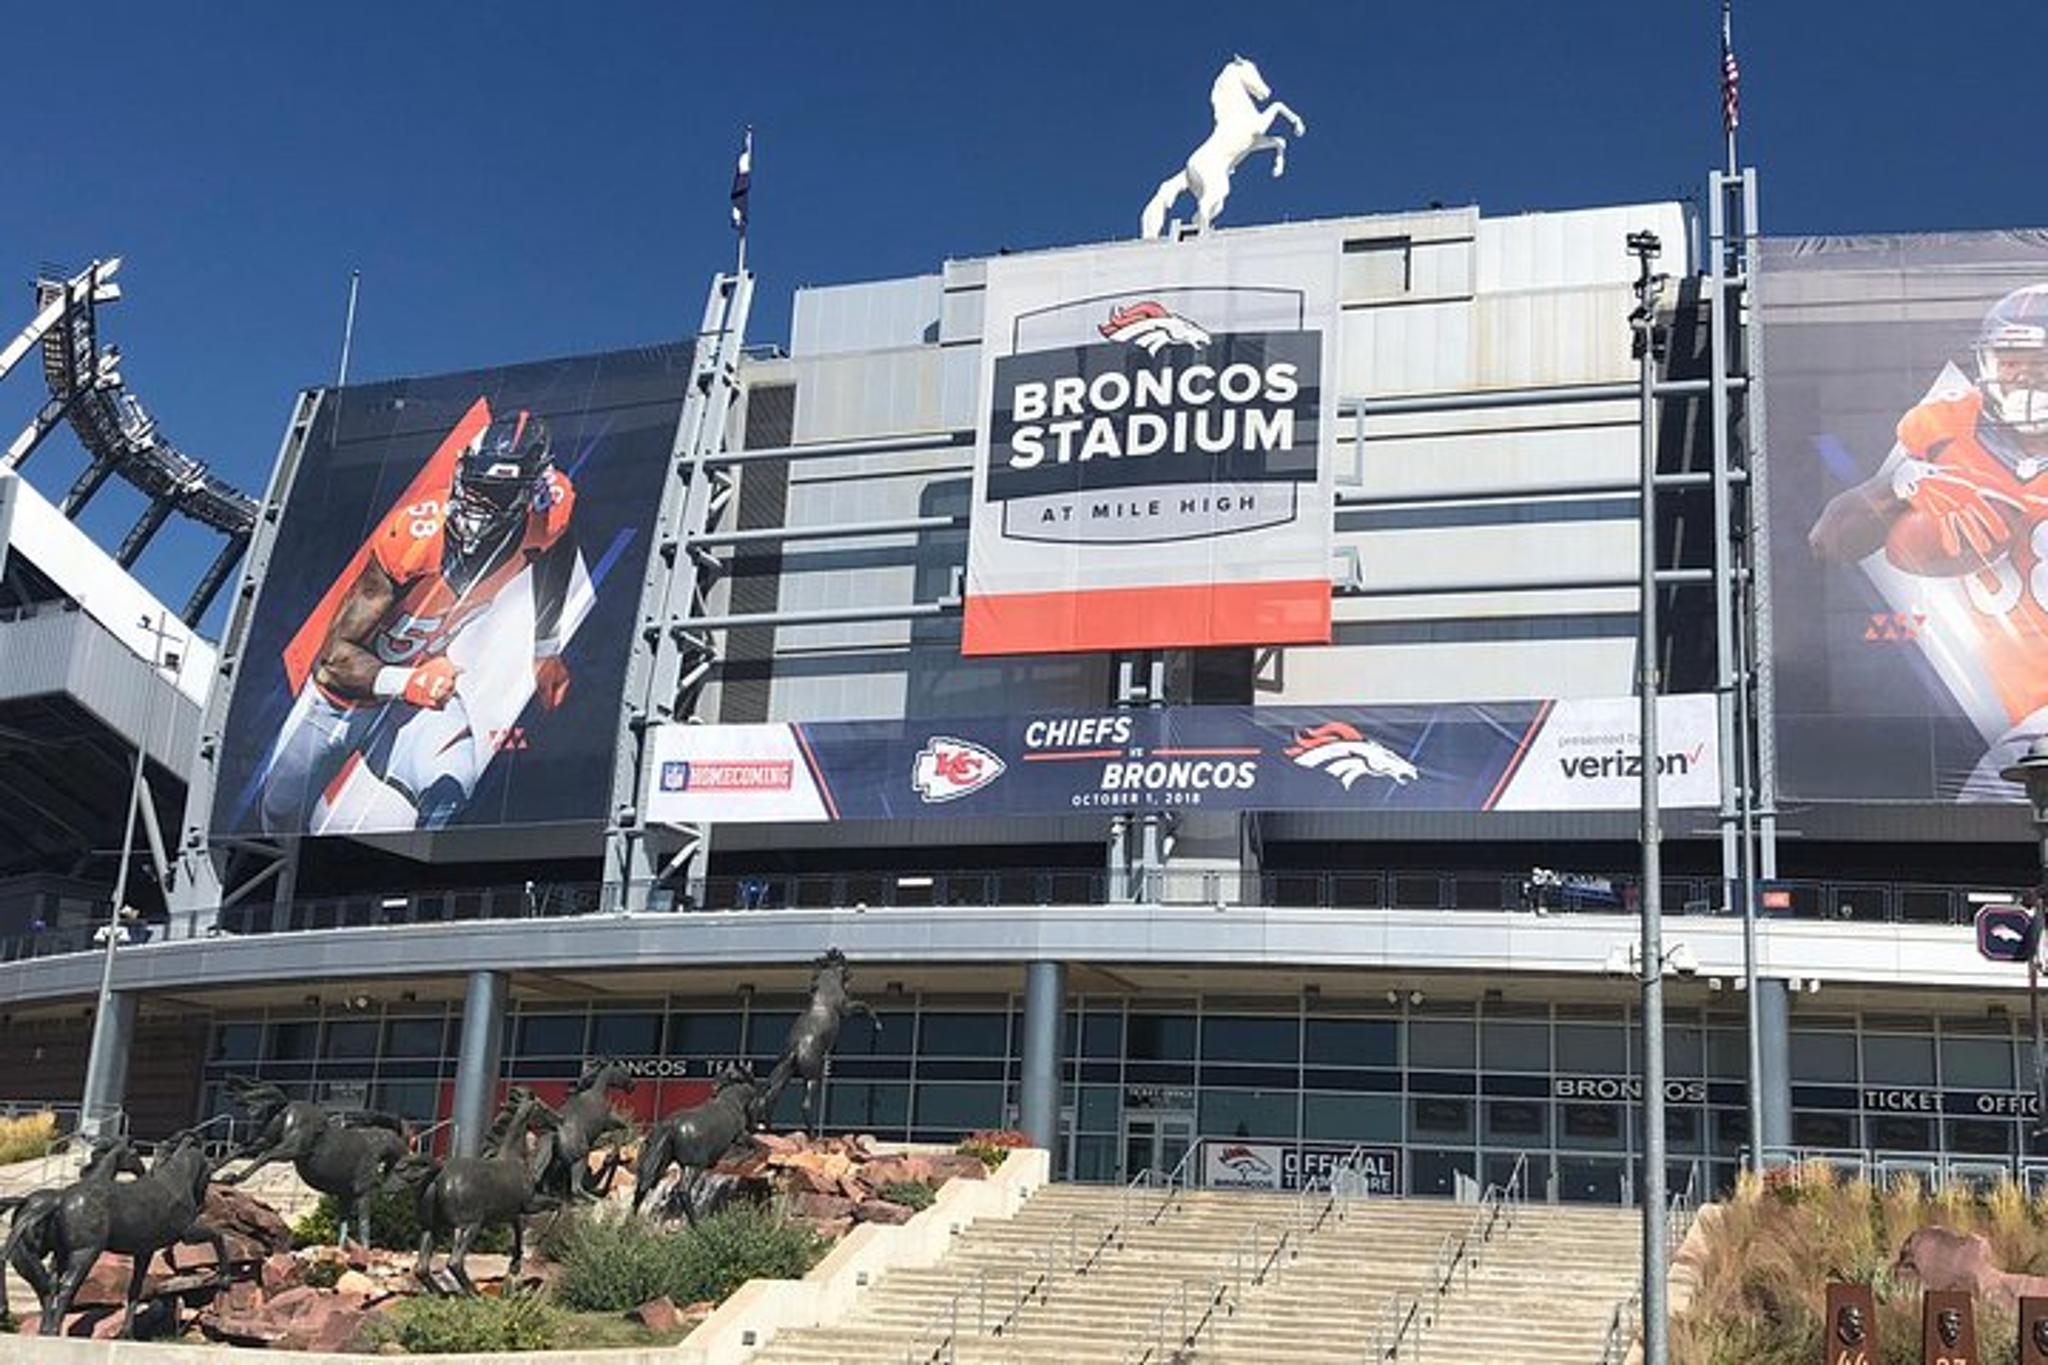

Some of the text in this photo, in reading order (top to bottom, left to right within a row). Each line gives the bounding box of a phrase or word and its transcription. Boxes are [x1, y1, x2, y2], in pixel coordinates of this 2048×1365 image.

[1013, 362, 1299, 422] BRONCOS
[1008, 408, 1295, 468] STADIUM
[1041, 496, 1256, 523] AT MILE HIGH
[1025, 716, 1132, 747] CHIEFS
[1558, 733, 1624, 747] presented
[1101, 761, 1257, 789] BRONCOS
[1071, 792, 1138, 807] OCTOBER
[1165, 792, 1201, 806] 2018
[1556, 1080, 1705, 1101] BRONOS
[1865, 1091, 2040, 1113] TICKET OFFIC
[1285, 1154, 1392, 1175] OFFICAL
